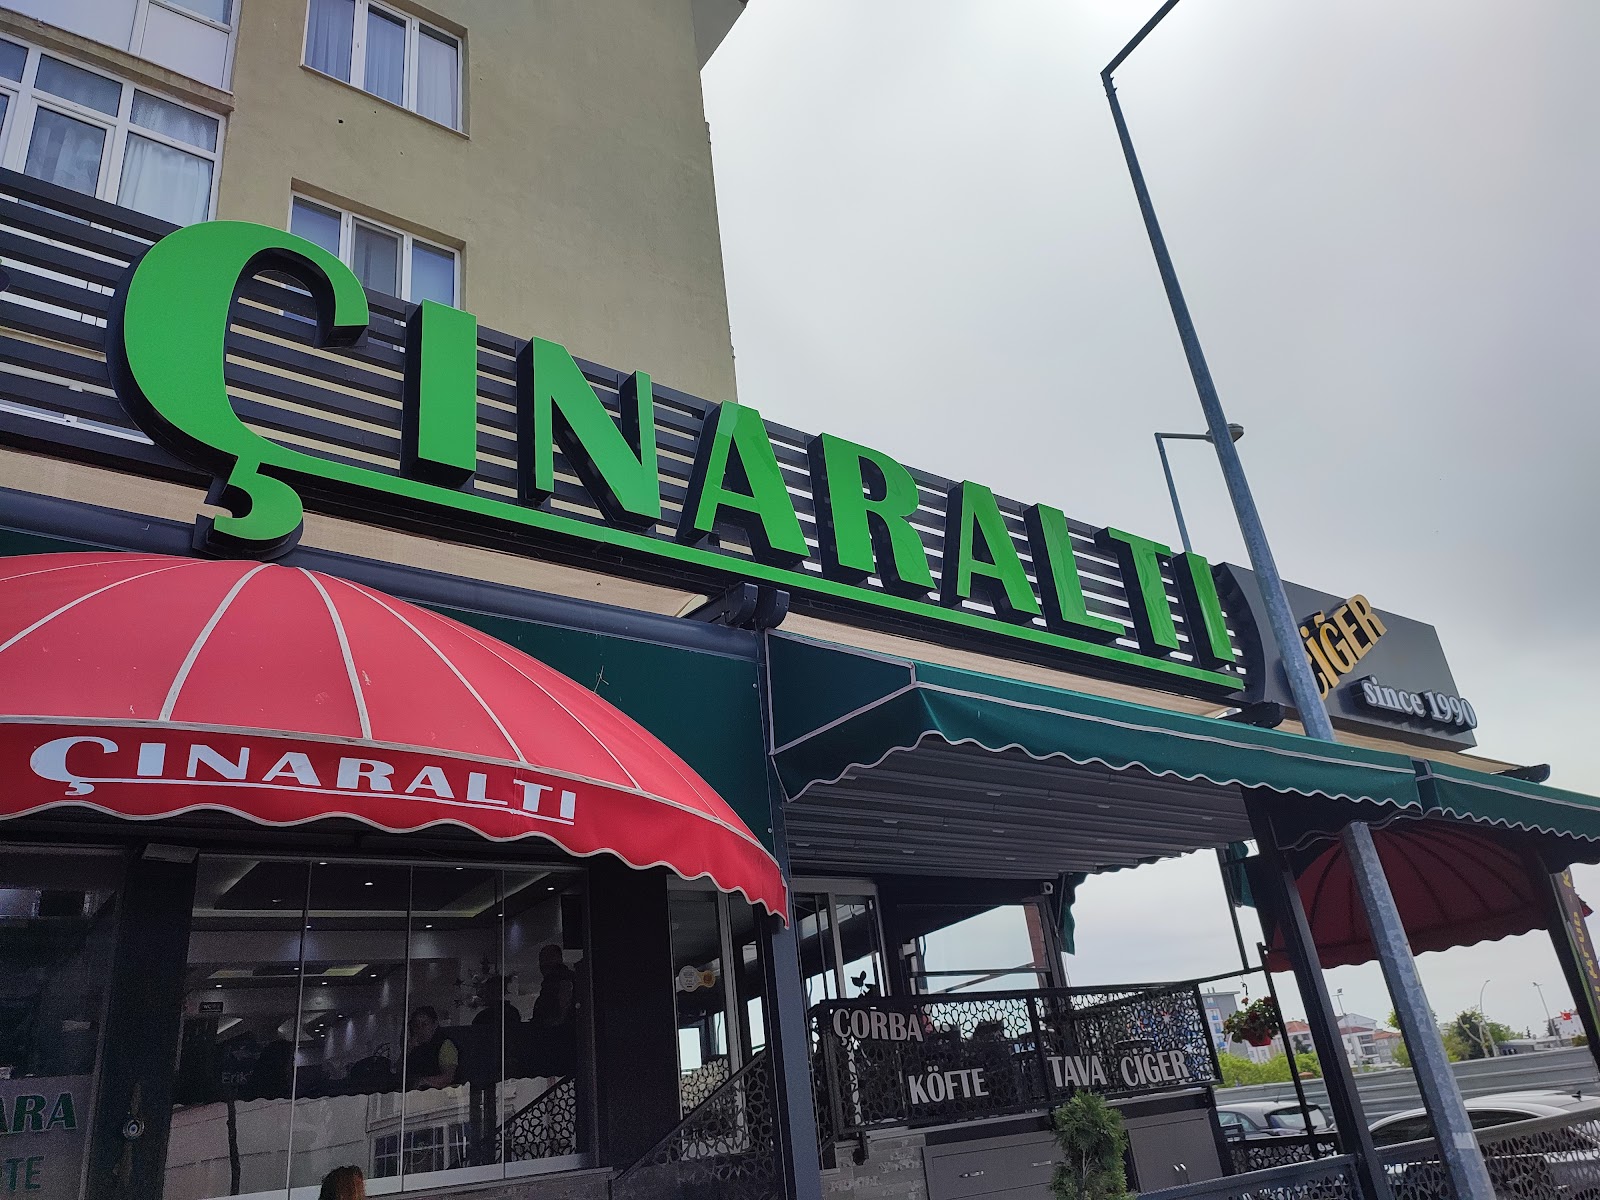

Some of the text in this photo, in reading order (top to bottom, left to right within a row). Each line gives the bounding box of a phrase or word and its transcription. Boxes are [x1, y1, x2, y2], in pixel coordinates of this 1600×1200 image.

[122, 219, 1243, 690] ÇINARALTI
[1361, 675, 1478, 729] since 1990
[29, 736, 577, 826] ÇINARALTI
[833, 1008, 924, 1046] ÇORBA
[908, 1065, 990, 1105] KÖFTE
[1047, 1046, 1190, 1088] TAVA CİĞER
[0, 1091, 78, 1135] RA
[0, 1155, 45, 1192] TE
